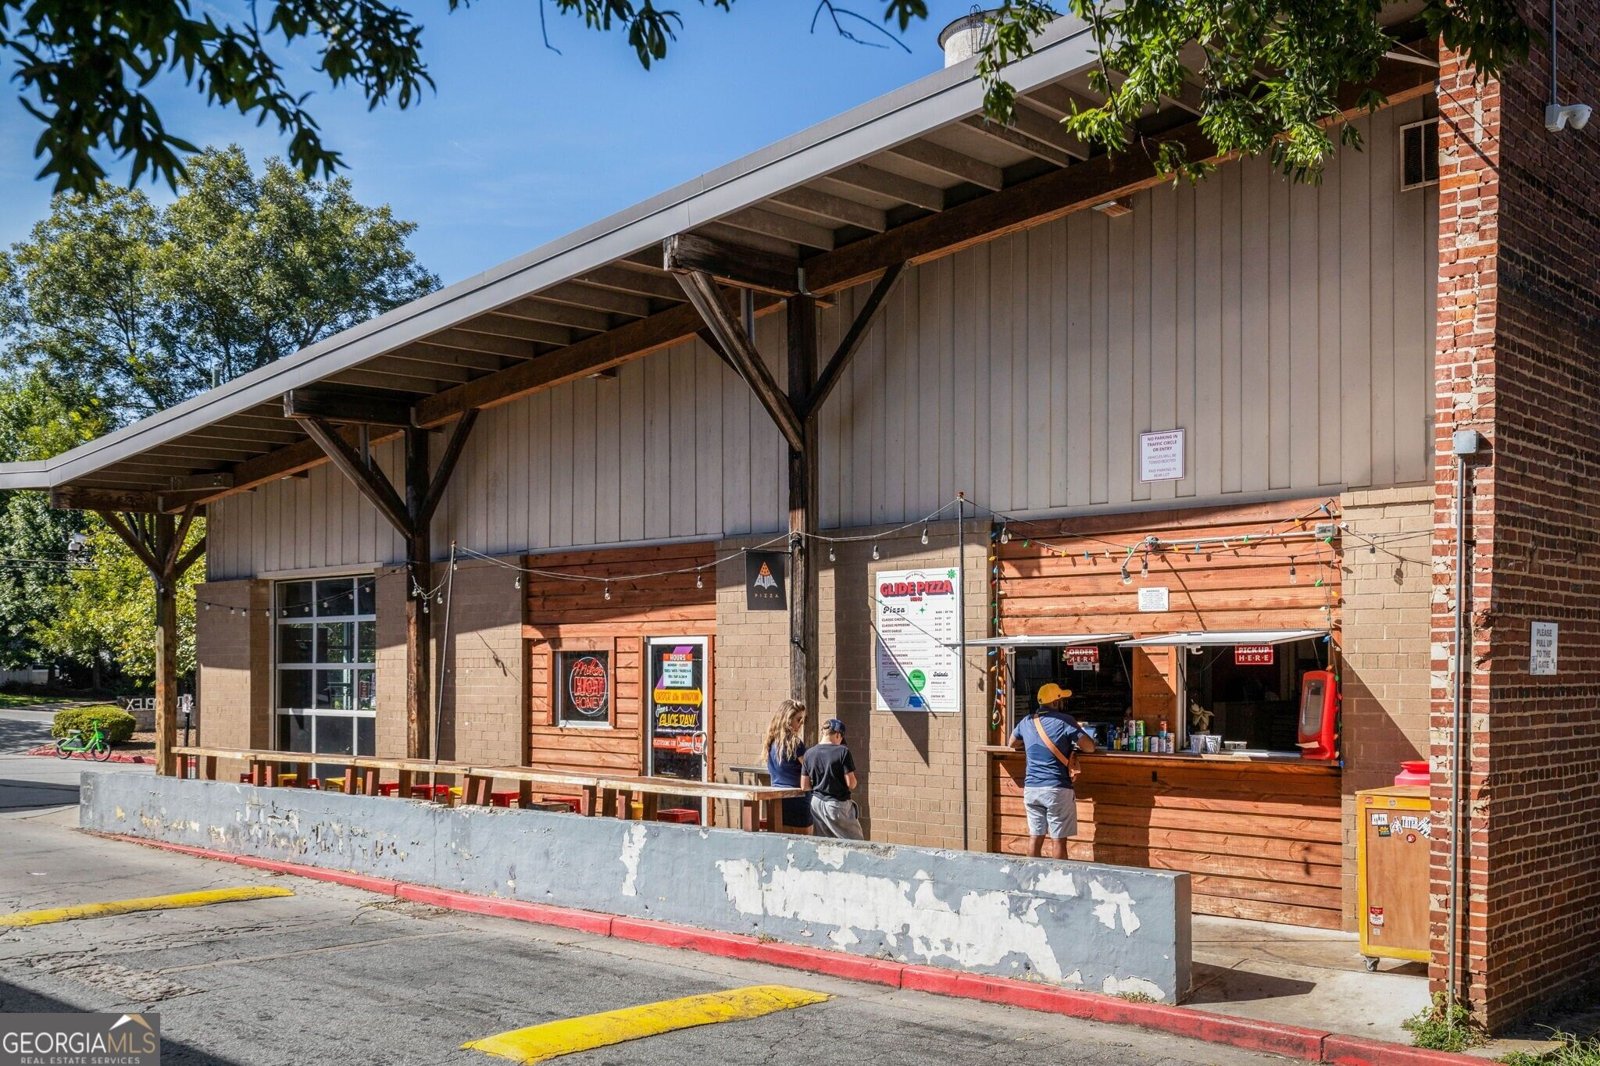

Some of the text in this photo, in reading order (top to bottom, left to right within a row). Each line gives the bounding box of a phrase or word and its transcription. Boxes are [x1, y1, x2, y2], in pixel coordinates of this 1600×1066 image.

[880, 580, 954, 597] GLIDE PIZZA
[883, 605, 906, 614] Pizza
[1536, 628, 1552, 637] PLEASE
[1536, 639, 1552, 647] PULL UP
[1543, 650, 1551, 658] THE
[1538, 660, 1549, 668] GATE
[574, 677, 604, 696] HOT
[575, 696, 603, 709] HONEY
